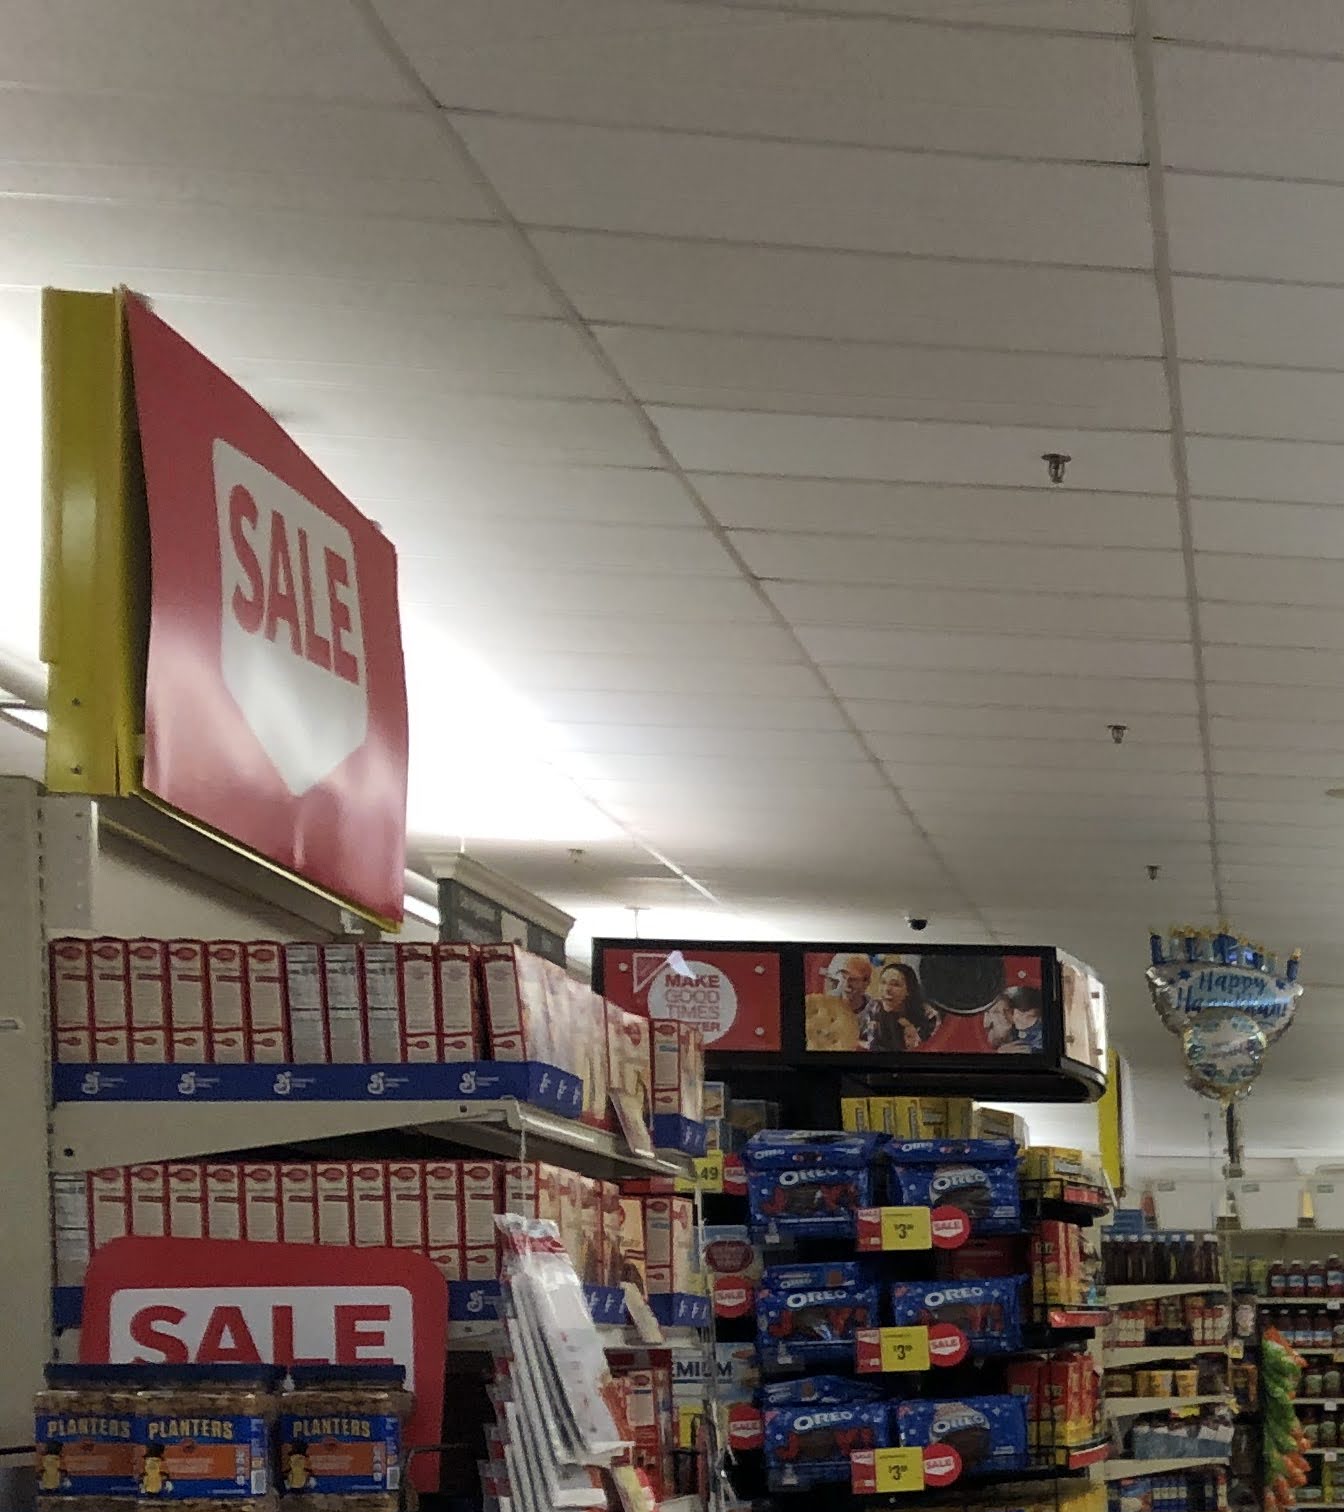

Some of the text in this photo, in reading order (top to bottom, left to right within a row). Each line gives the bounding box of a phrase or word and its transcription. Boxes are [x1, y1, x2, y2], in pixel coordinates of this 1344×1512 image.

[228, 484, 360, 685] SALE
[665, 974, 720, 988] MAKE
[665, 989, 720, 1003] GOOD
[666, 1004, 720, 1019] TIMES
[933, 1174, 986, 1190] OREO
[786, 1291, 846, 1308] OREO
[925, 1287, 983, 1306] OREO
[129, 1304, 392, 1365] SALE
[931, 1338, 959, 1349] SALE
[47, 1418, 131, 1438] PLANTERS
[148, 1419, 233, 1440] PLANTERS
[293, 1418, 370, 1438] PLANTERS
[794, 1411, 852, 1431] OREO
[925, 1459, 952, 1469] SALE
